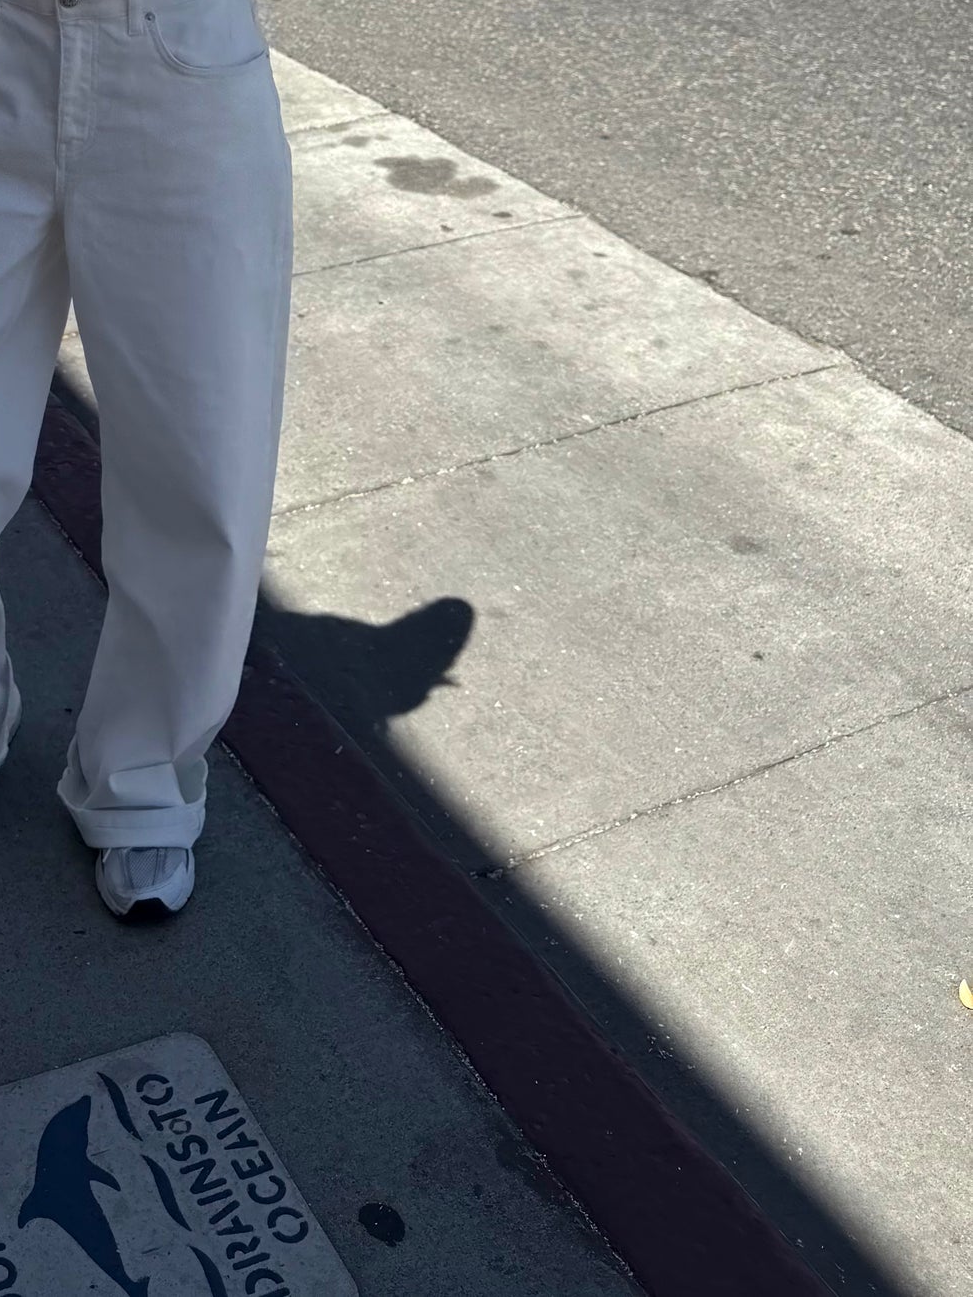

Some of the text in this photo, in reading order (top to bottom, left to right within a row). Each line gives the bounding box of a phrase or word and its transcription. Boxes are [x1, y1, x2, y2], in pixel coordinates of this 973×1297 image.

[136, 1073, 290, 1297] DRAINS TO
[194, 1089, 309, 1244] OCEAN
